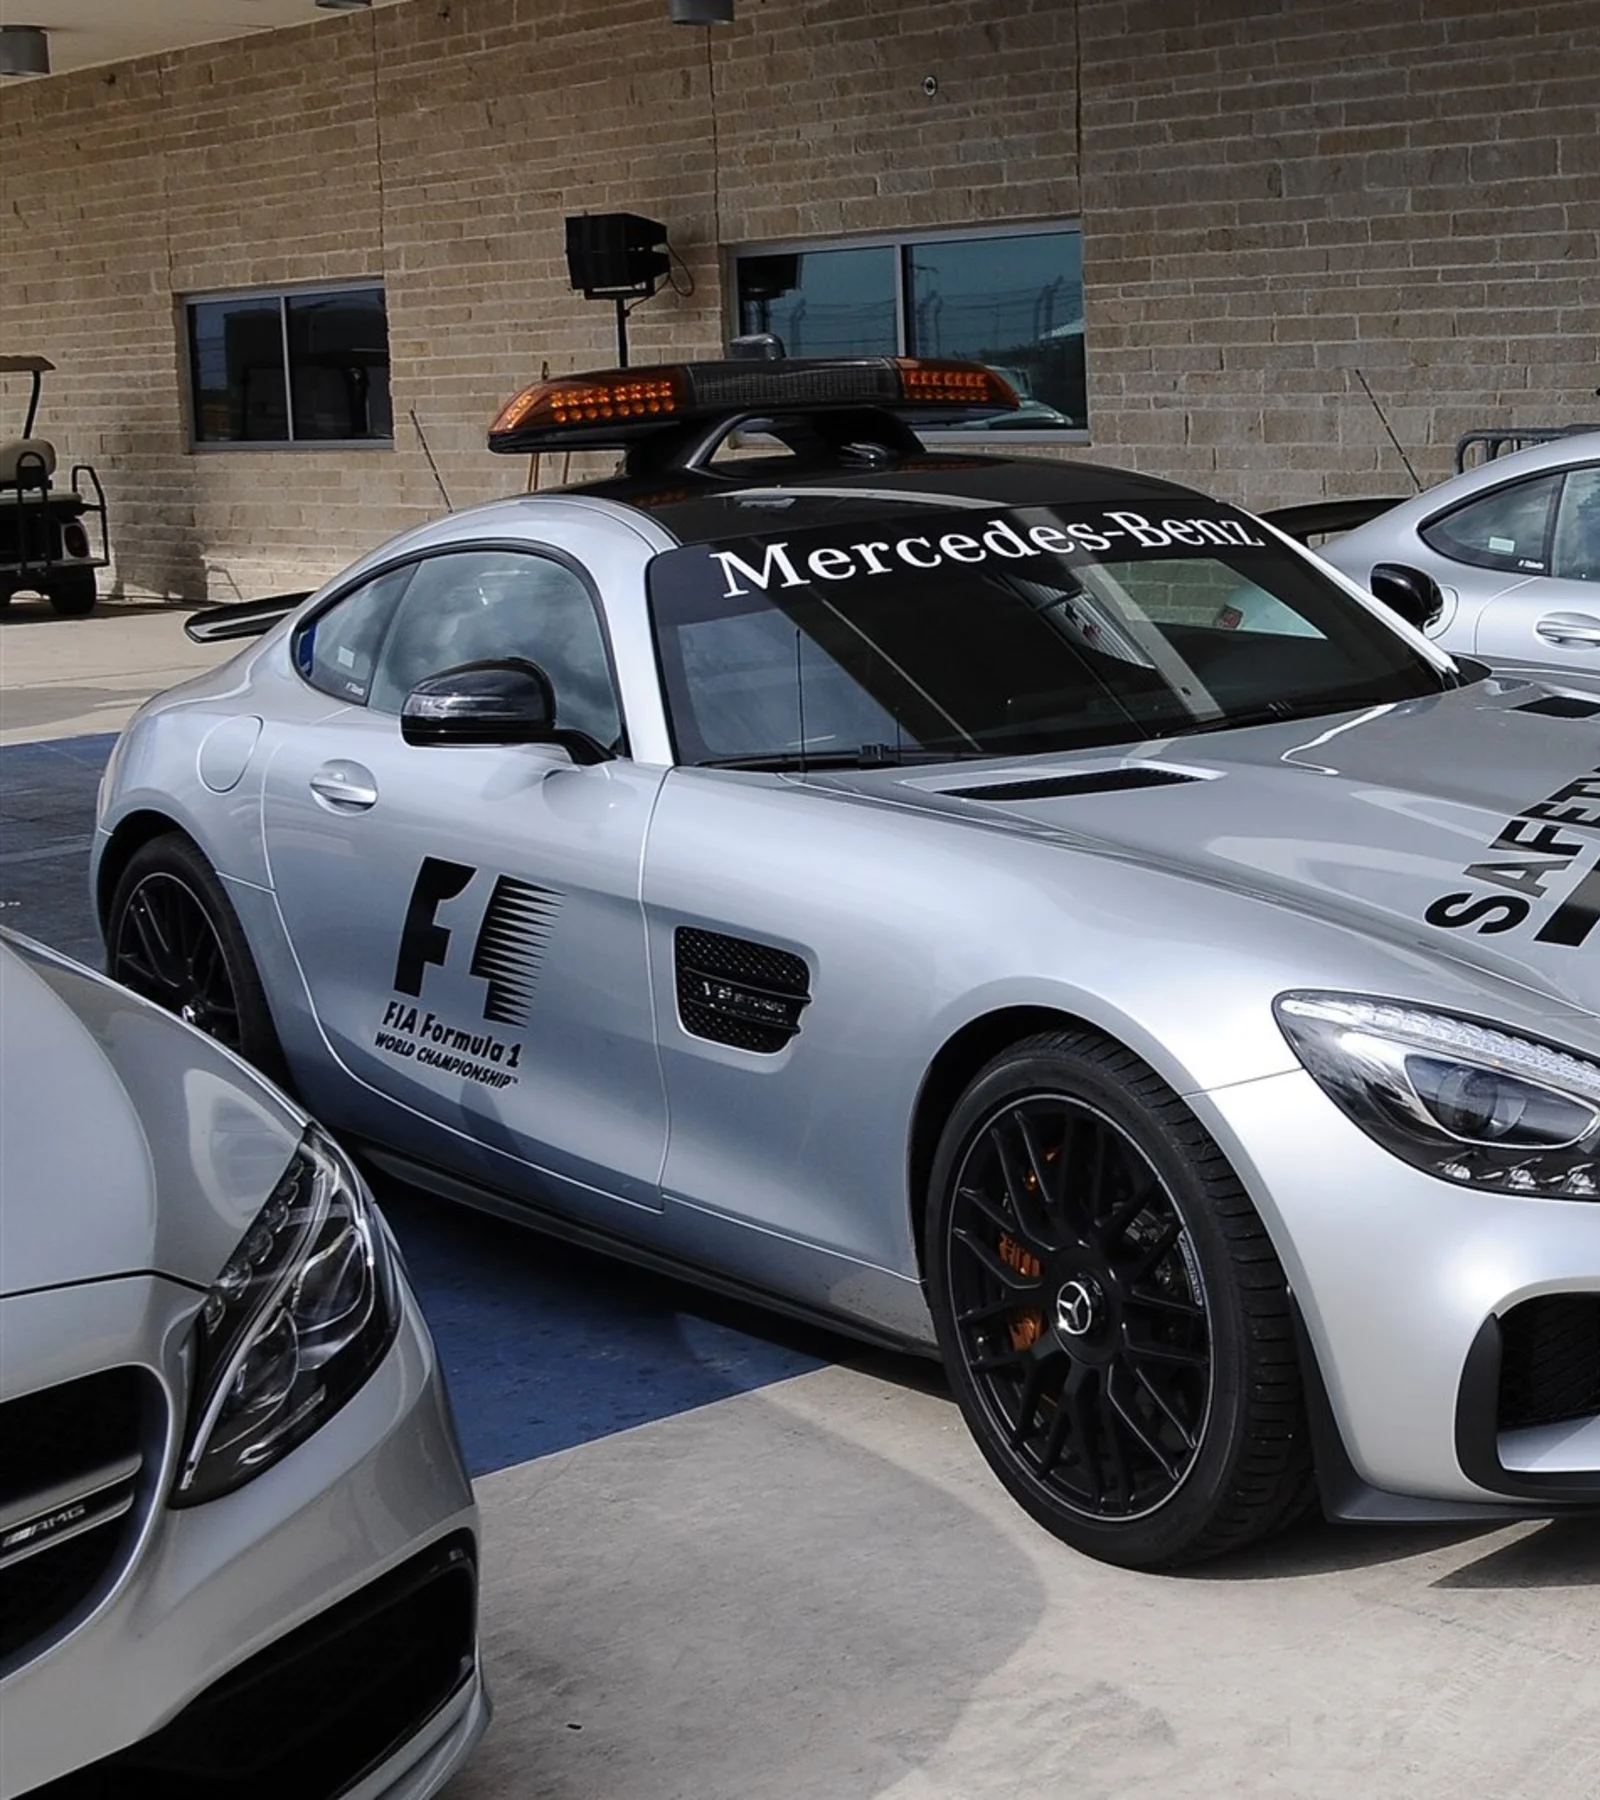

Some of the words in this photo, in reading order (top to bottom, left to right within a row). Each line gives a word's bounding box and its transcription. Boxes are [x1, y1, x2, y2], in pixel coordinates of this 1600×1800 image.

[709, 511, 1266, 599] Mercedes-Benz
[374, 1032, 416, 1057] WORLD
[382, 1001, 418, 1034] FIA
[419, 1013, 505, 1062] Formula
[506, 1043, 521, 1068] 1
